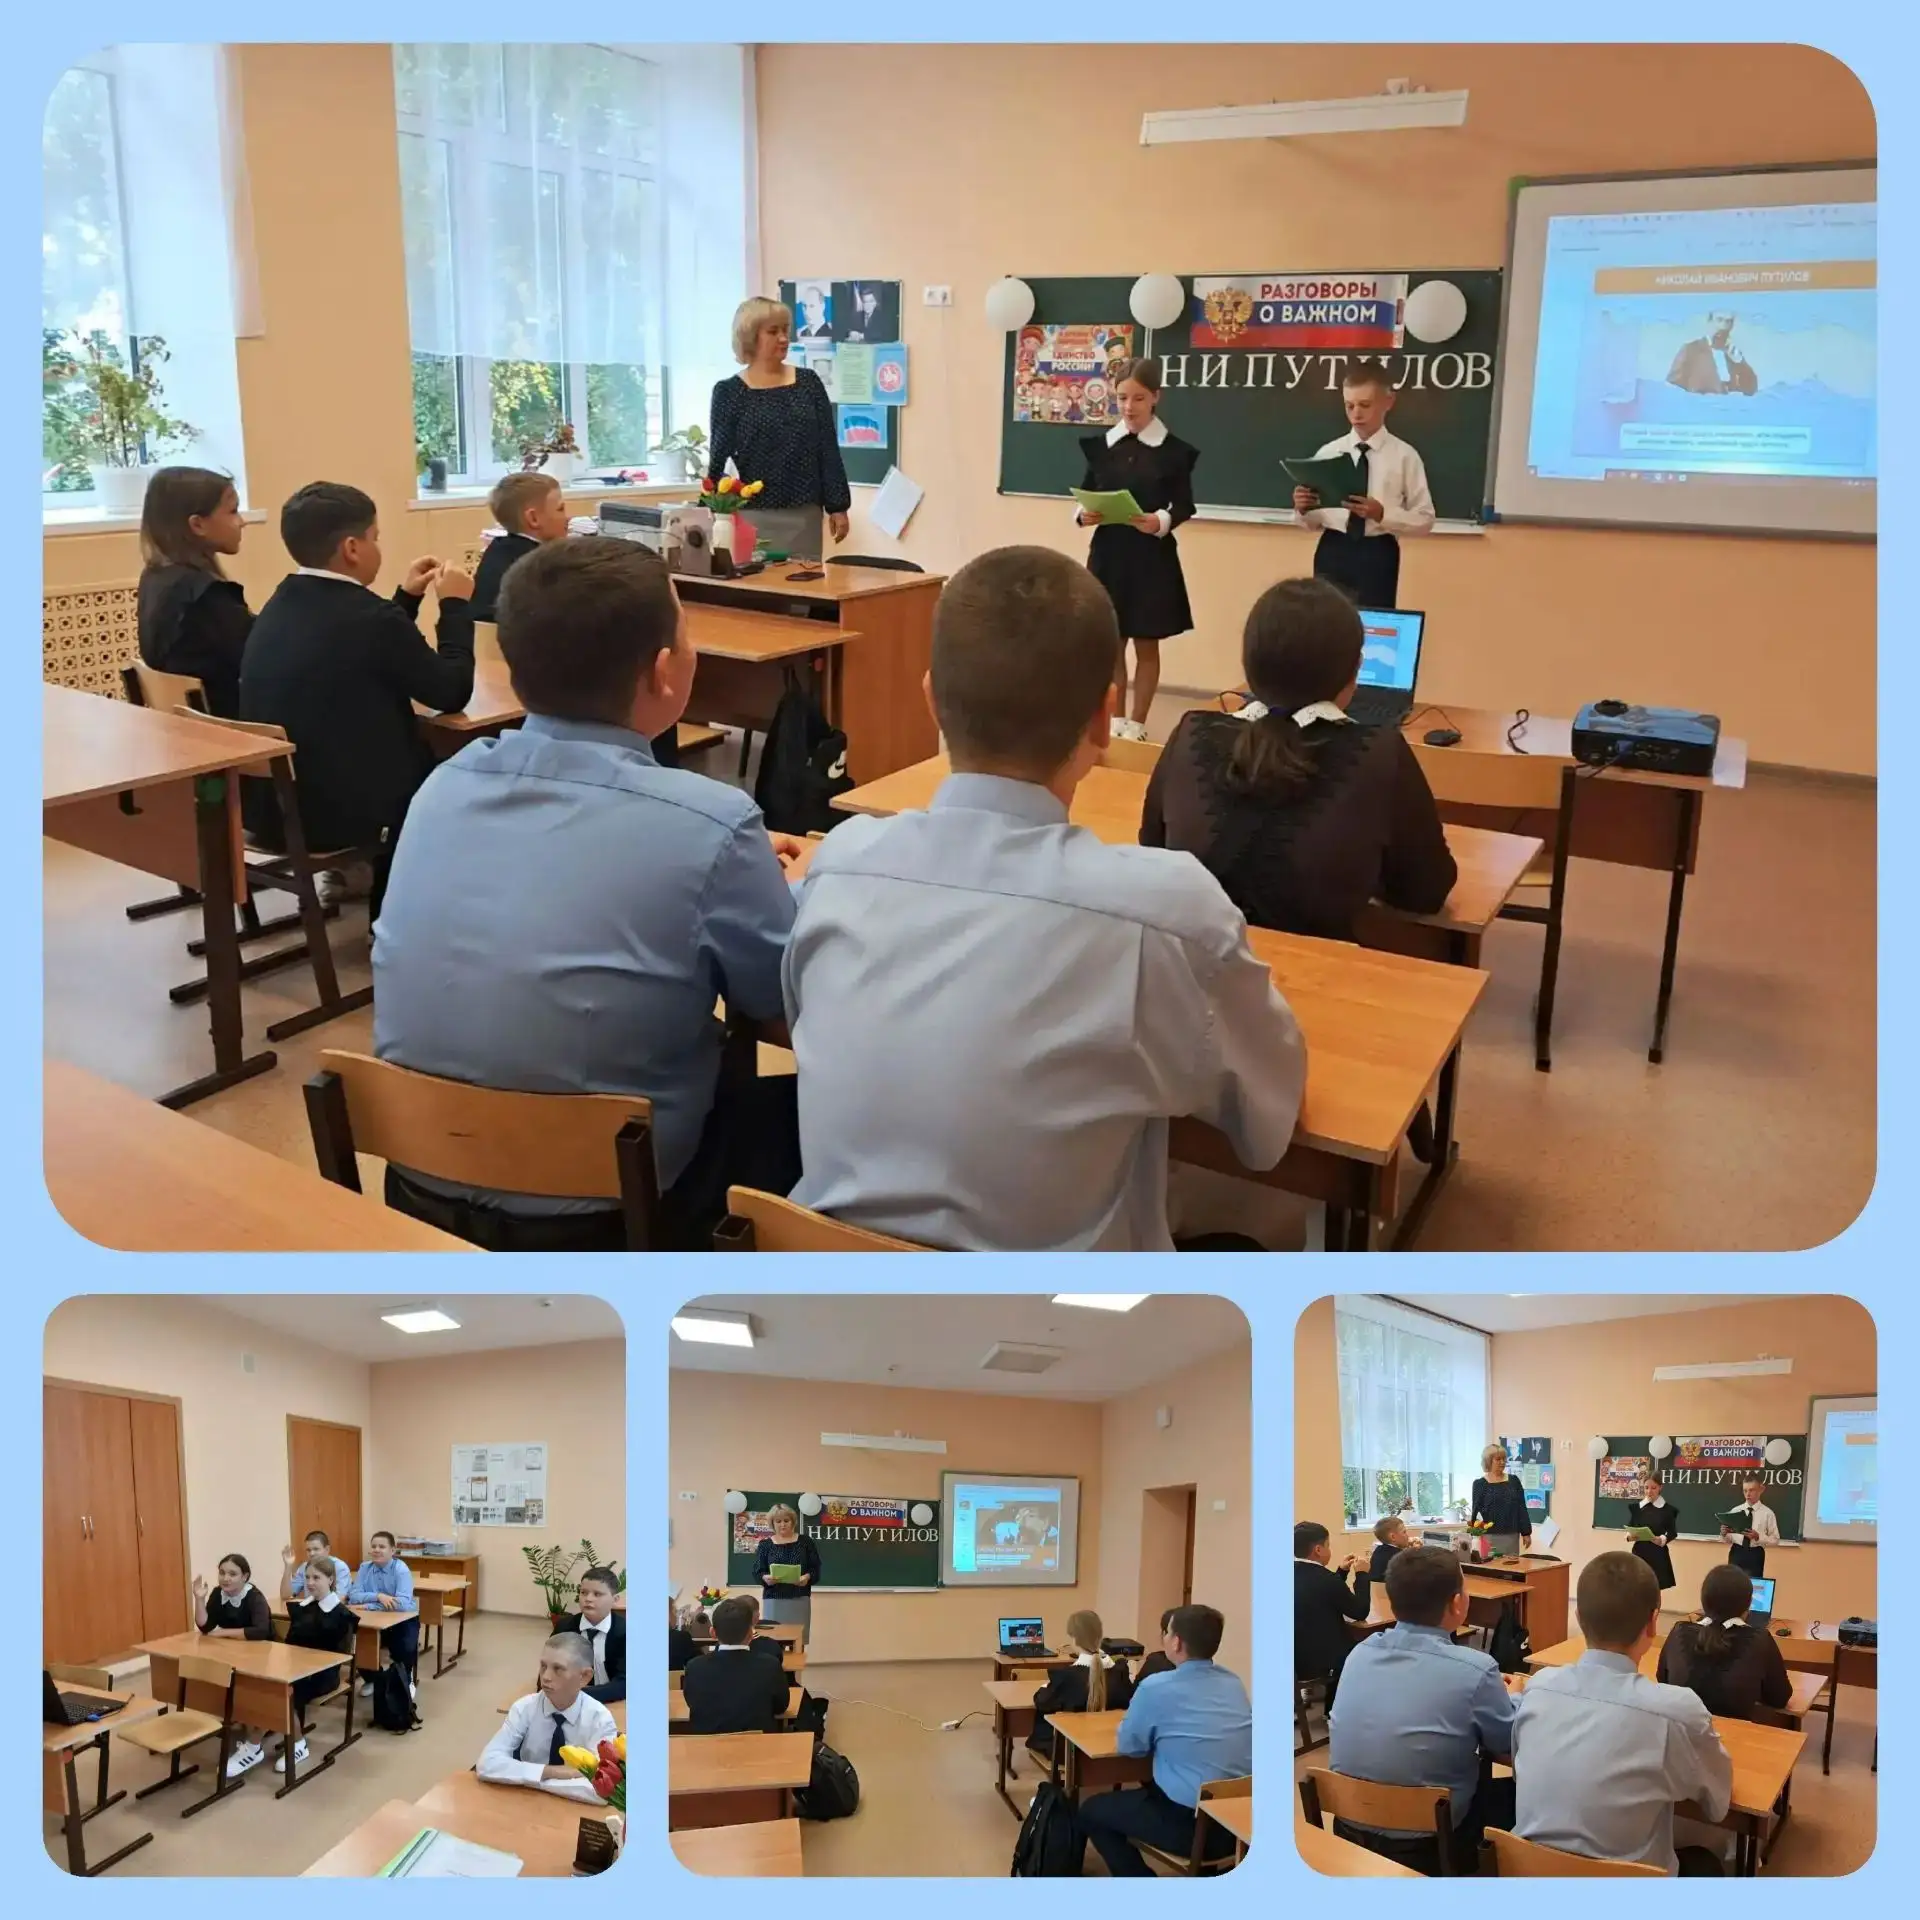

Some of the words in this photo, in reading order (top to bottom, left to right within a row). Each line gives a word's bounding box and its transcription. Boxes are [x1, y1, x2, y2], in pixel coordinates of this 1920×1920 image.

[1261, 281, 1377, 299] РАЗГОВОРЫ
[1259, 304, 1274, 323] О
[1281, 303, 1377, 323] ВАЖНОМ
[1704, 1439, 1754, 1447] РАЗГОВОРЫ
[1703, 1448, 1711, 1457] О
[1713, 1448, 1754, 1457] ВАЖНОМ
[850, 1500, 897, 1509] РАЗГОВОРЫ
[850, 1508, 857, 1516] О
[860, 1508, 897, 1517] ВАЖНОМ
